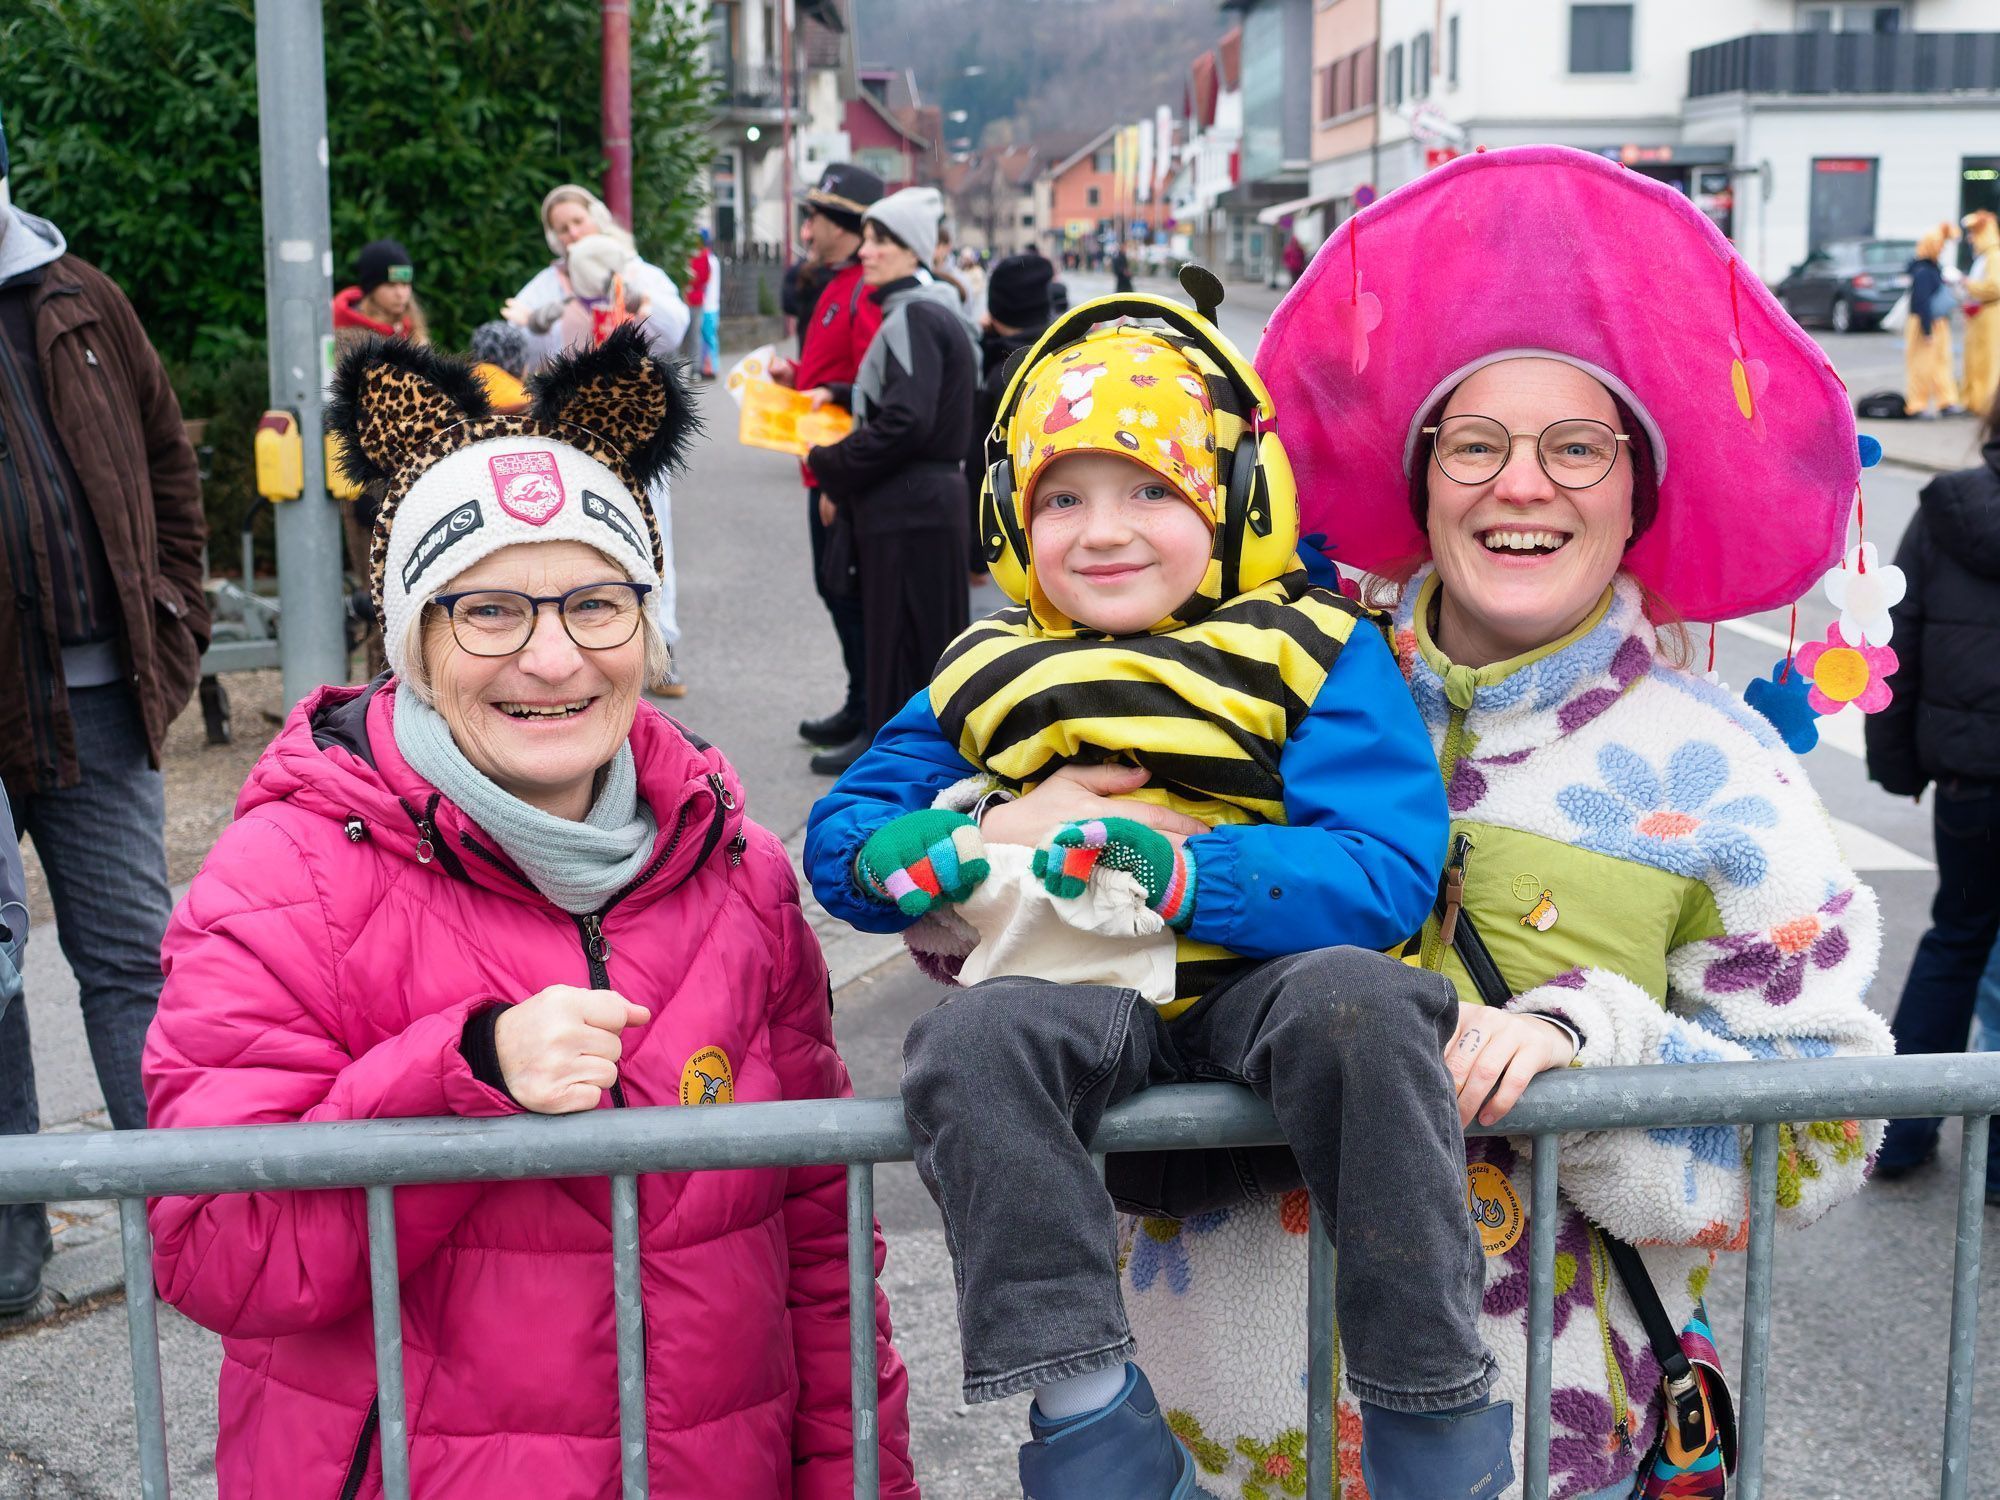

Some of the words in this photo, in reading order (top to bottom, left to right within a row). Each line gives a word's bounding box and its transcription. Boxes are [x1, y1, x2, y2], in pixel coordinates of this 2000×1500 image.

[494, 453, 550, 463] COUPE
[1467, 1166, 1490, 1176] Götzis
[1500, 1179, 1520, 1241] Fasnatumzug
[1470, 1472, 1492, 1495] reima
